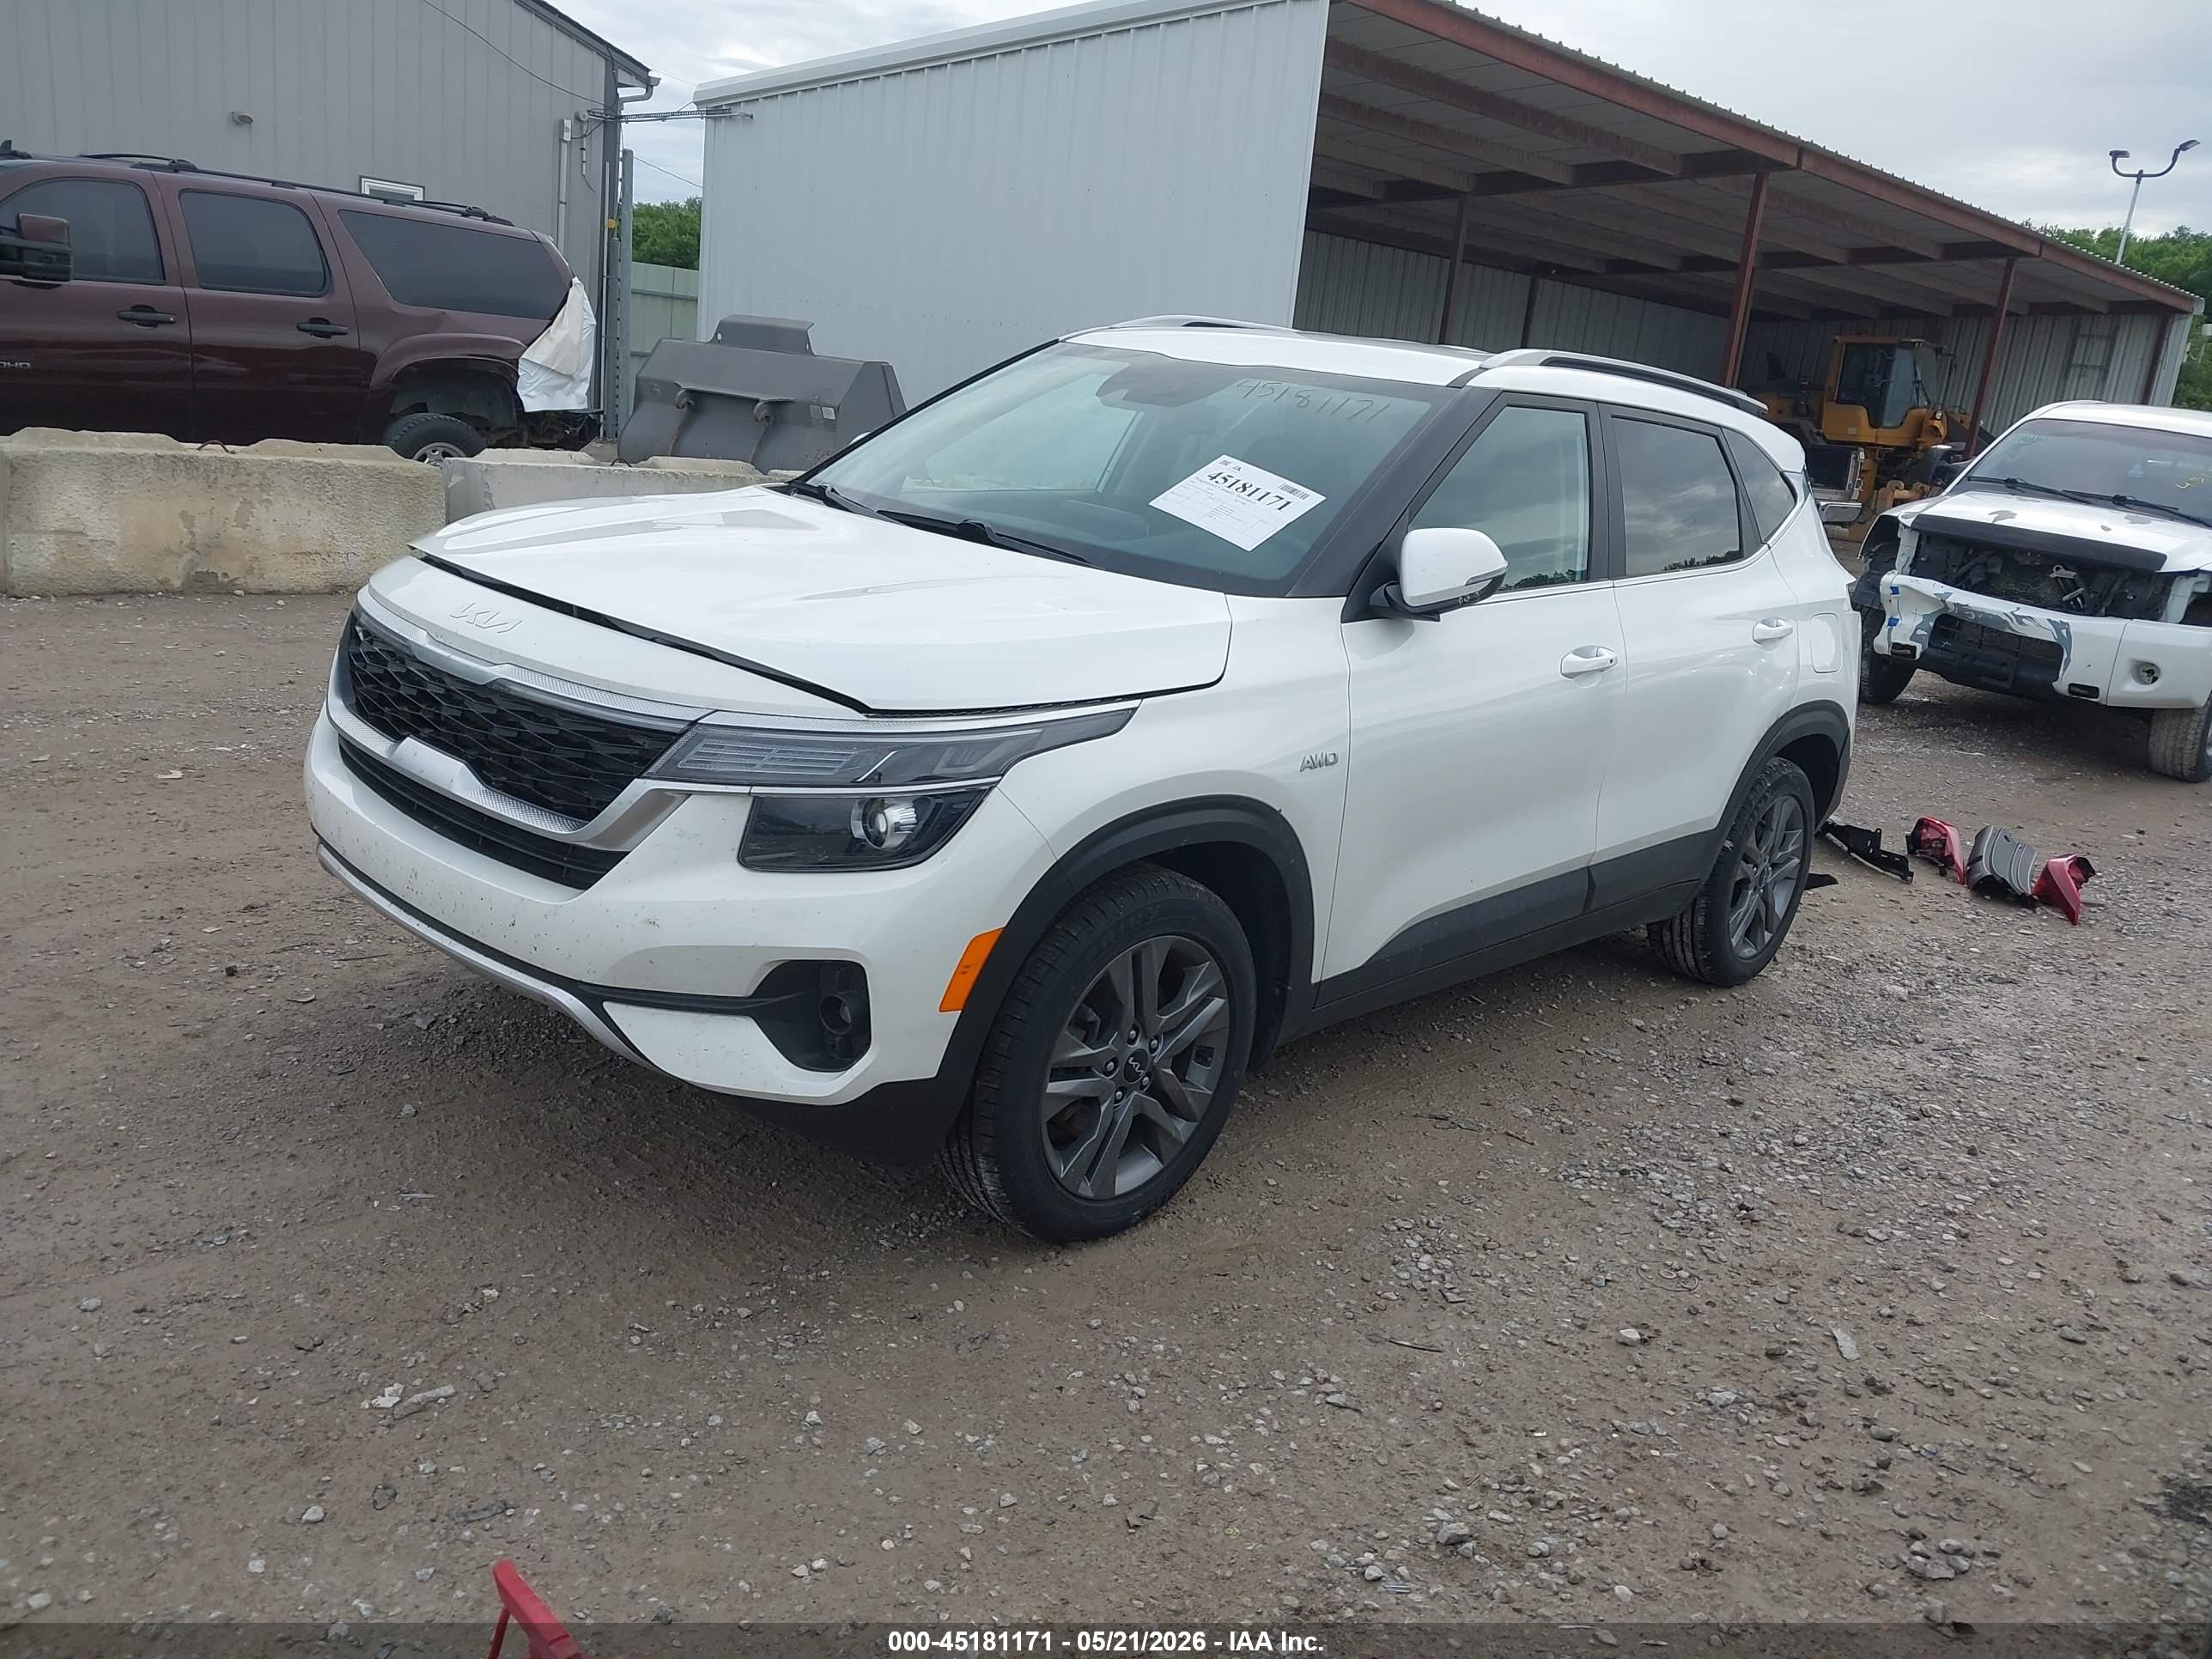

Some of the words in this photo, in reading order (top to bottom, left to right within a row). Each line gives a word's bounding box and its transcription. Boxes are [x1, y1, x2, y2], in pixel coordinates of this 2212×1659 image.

[1236, 380, 1390, 422] 45181171
[1206, 471, 1294, 511] 45181171
[1299, 752, 1339, 772] AWD
